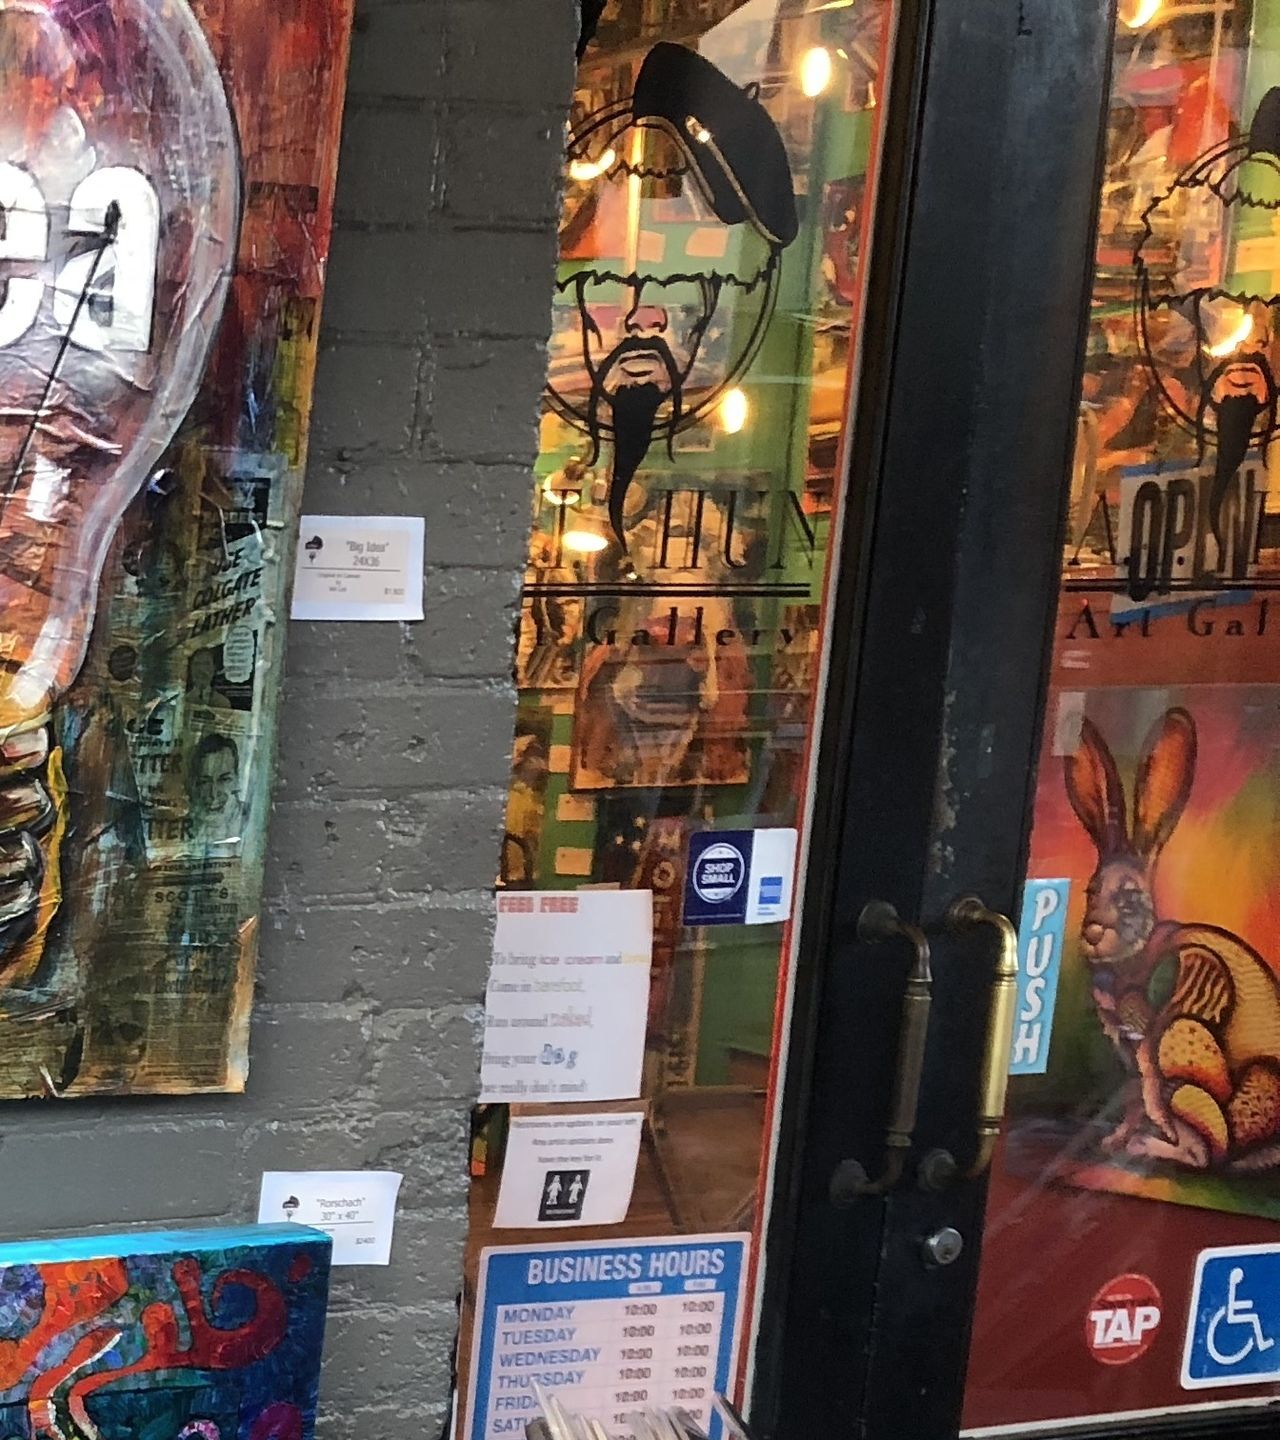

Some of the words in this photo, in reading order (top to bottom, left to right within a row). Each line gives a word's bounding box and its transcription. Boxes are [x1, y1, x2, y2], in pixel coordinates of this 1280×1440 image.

[704, 862, 735, 874] SHOP
[700, 873, 736, 885] SMALL
[1013, 888, 1059, 1064] PUSH
[527, 1253, 642, 1285] BUSINESS
[648, 1248, 725, 1278] HOURS
[503, 1306, 576, 1324] MONDAY
[624, 1303, 657, 1316] 10:00
[501, 1327, 577, 1345] TUESDAY
[622, 1325, 655, 1338] 10:00
[1090, 1306, 1160, 1345] TAP
[499, 1347, 602, 1367] WEDNESDAY
[620, 1347, 653, 1360] 10:00
[618, 1367, 652, 1380] 10:00
[495, 1394, 552, 1412] FRID
[615, 1389, 648, 1402] 10:00
